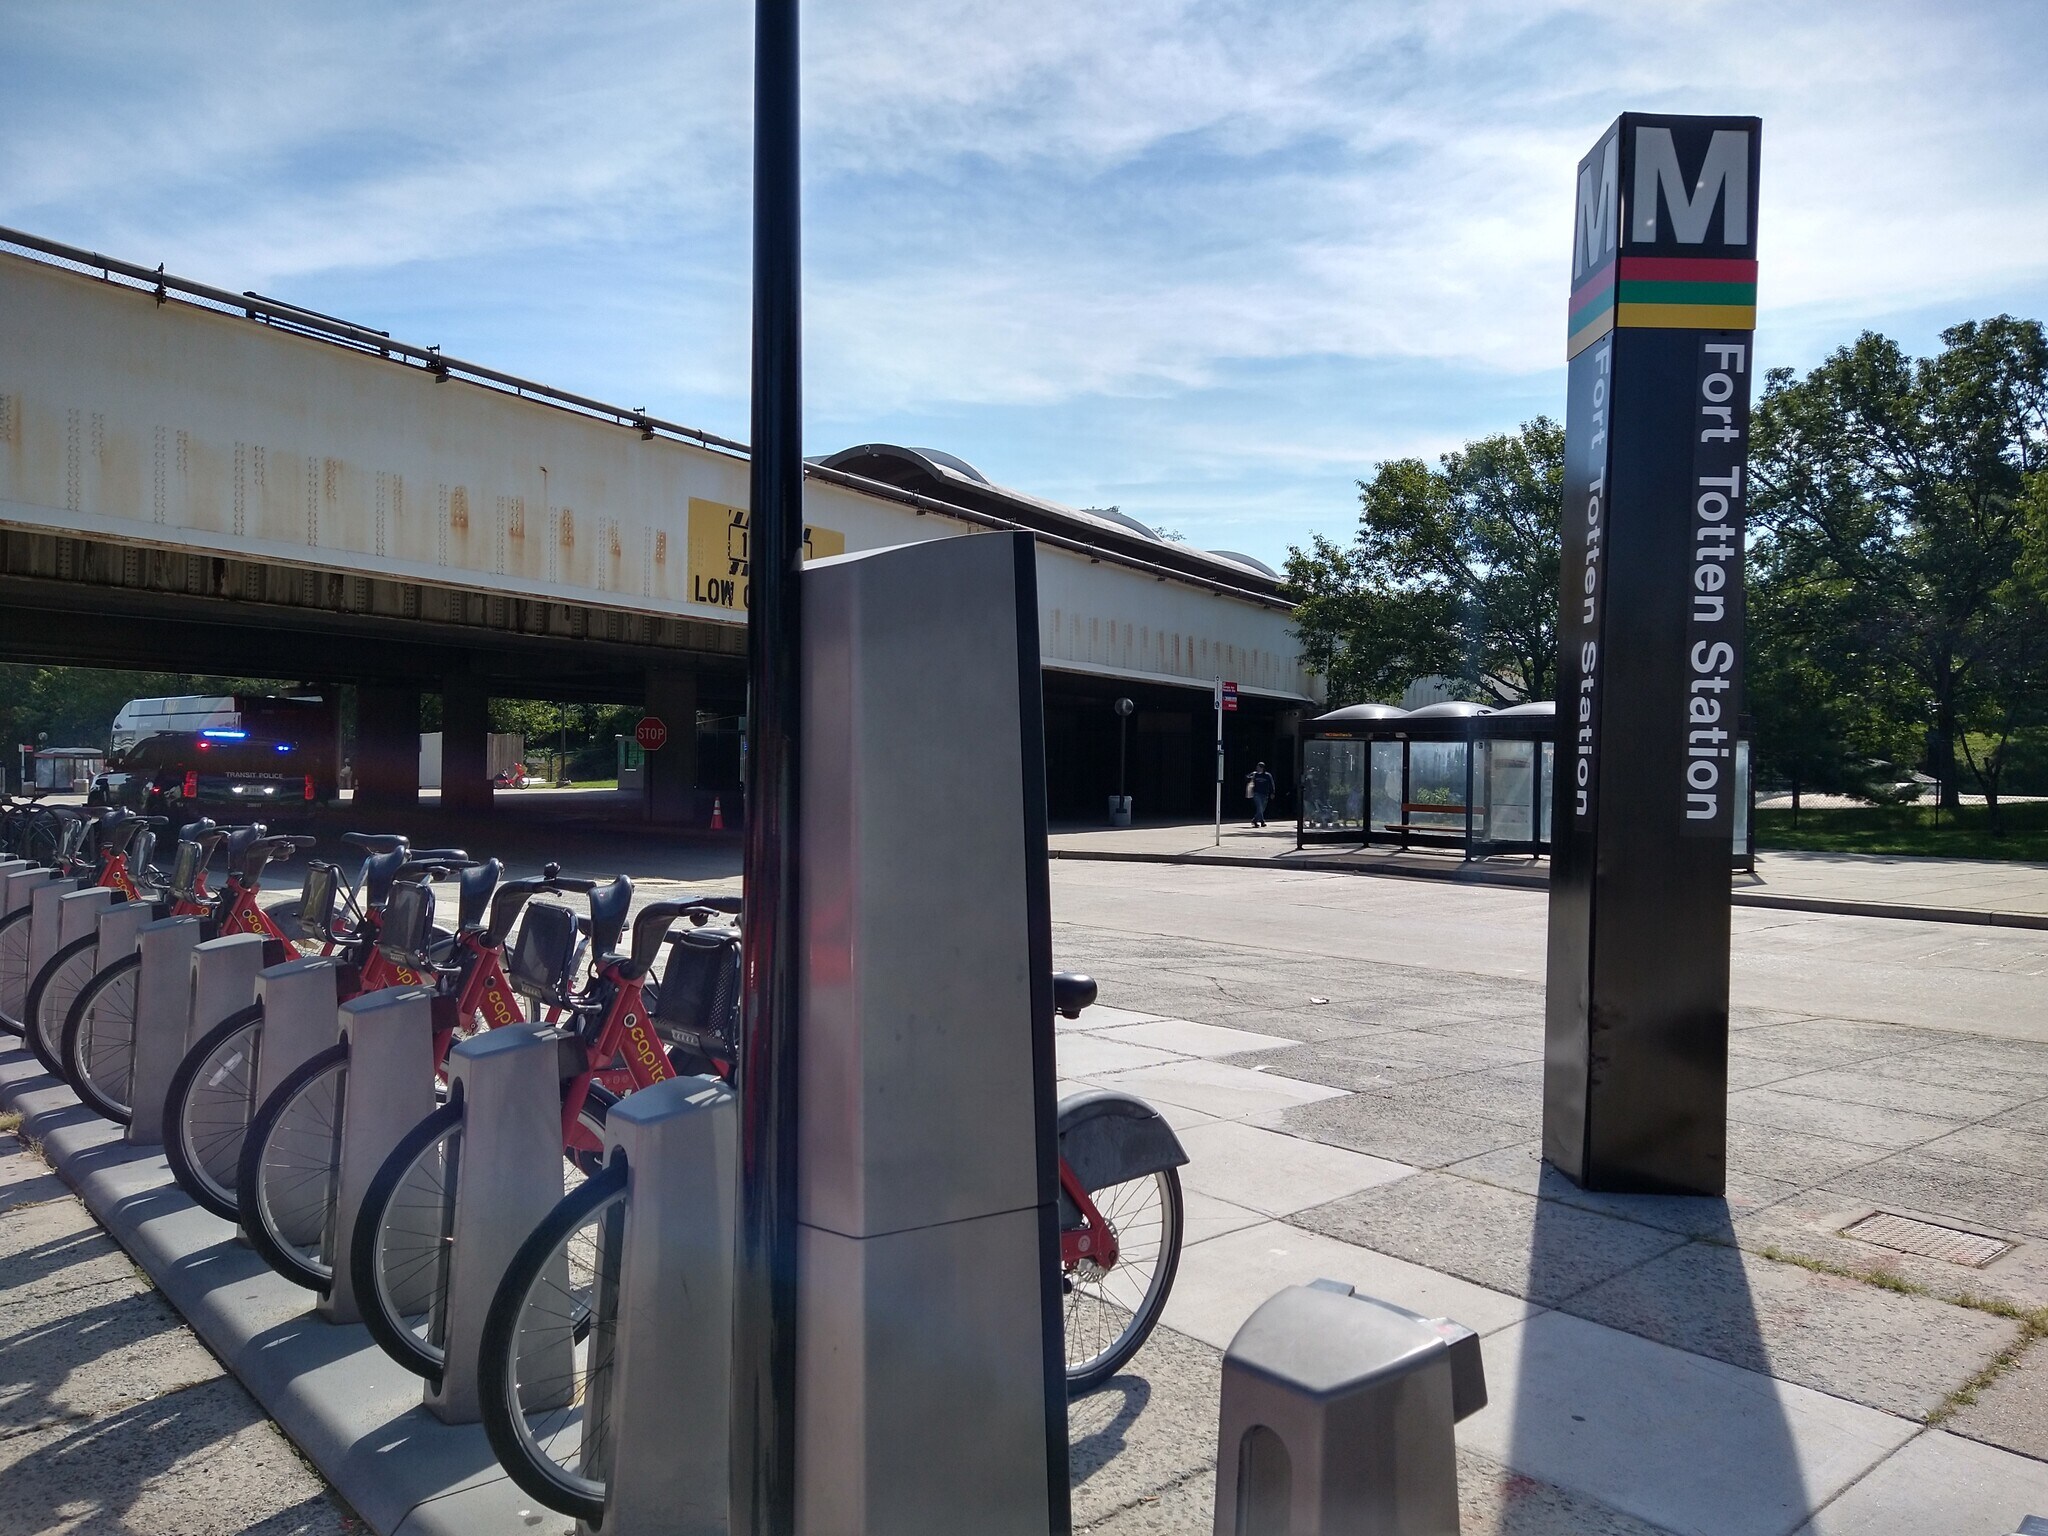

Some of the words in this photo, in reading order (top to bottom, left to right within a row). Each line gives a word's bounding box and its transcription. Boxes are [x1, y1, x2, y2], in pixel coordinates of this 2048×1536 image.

[1574, 133, 1617, 281] M
[1631, 126, 1749, 245] M
[1591, 344, 1610, 450] Fort
[1700, 343, 1745, 443] Fort
[694, 575, 734, 607] LOW
[1583, 467, 1604, 624] Totten
[1693, 466, 1740, 622] Totten
[225, 771, 257, 779] TRANSIT
[258, 772, 284, 780] POLICE
[638, 728, 664, 740] STOP
[1576, 641, 1597, 816] Station
[1686, 640, 1734, 820] Station
